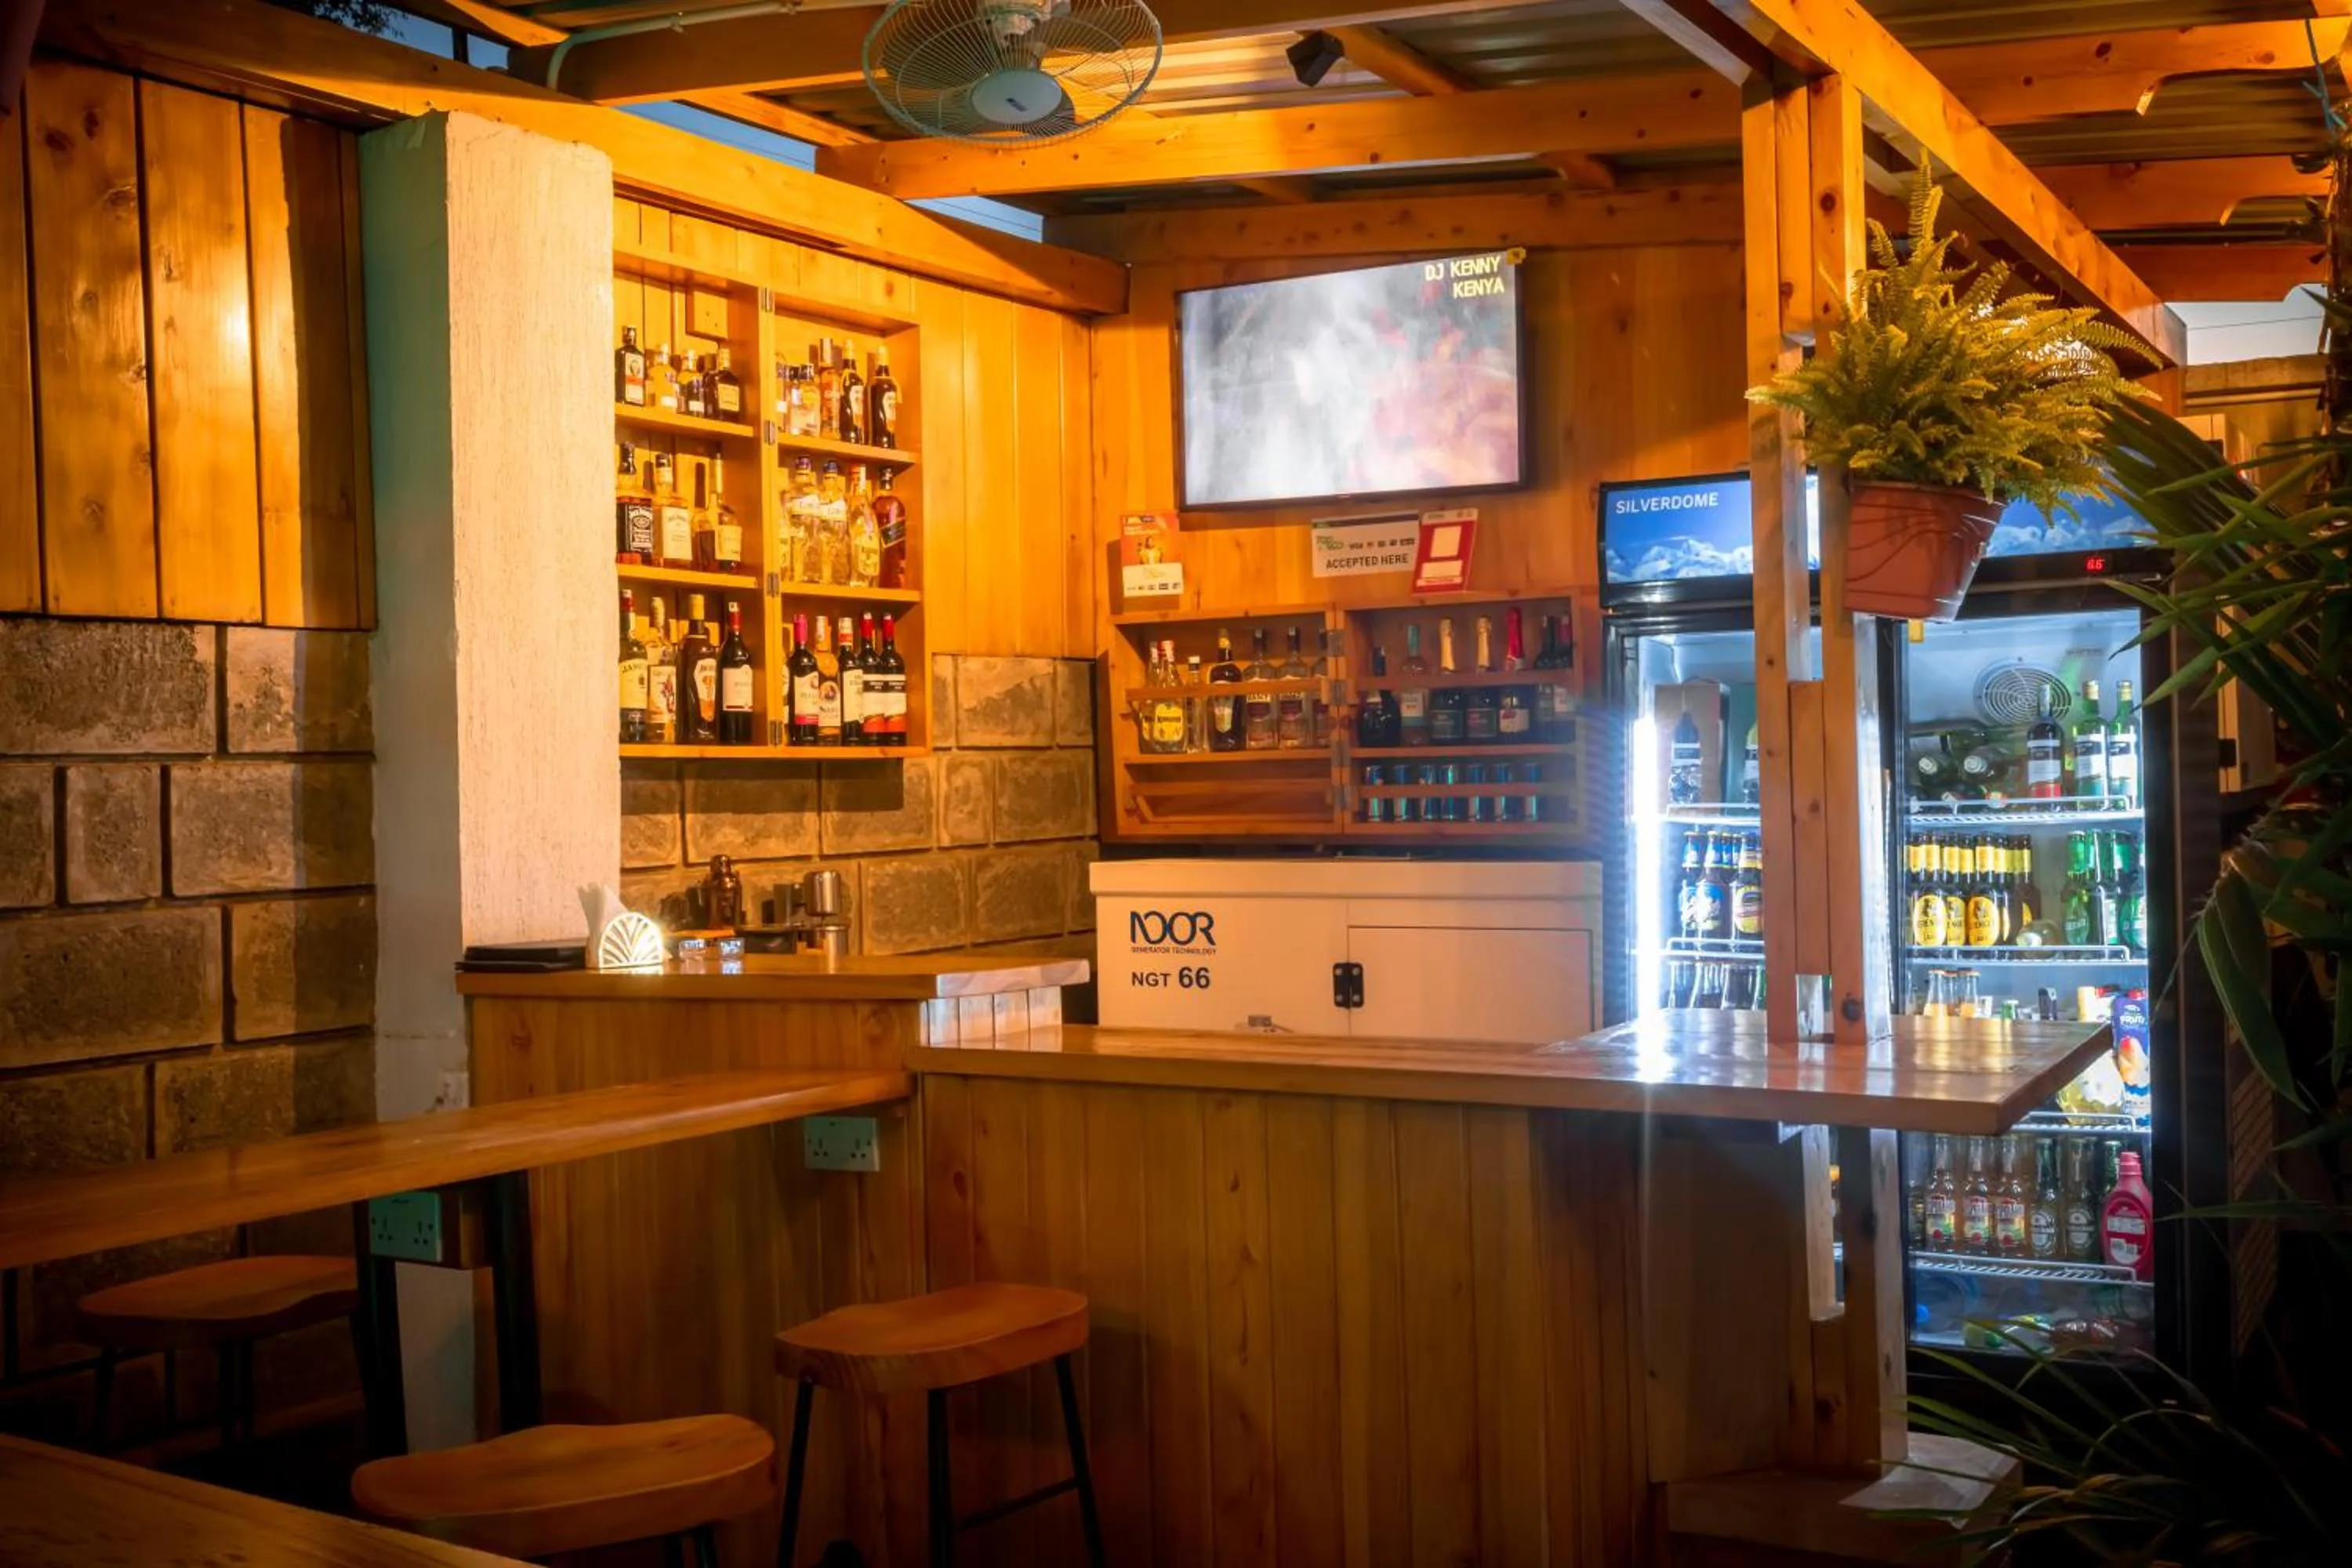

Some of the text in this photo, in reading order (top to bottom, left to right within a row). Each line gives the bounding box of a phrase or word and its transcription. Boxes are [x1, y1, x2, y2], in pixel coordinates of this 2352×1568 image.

[1425, 255, 1501, 281] DJ KENNY
[1453, 276, 1504, 299] KENYA
[1615, 492, 1719, 514] SILVERDOME
[1326, 554, 1409, 569] ACCEPTED HERE
[1130, 910, 1216, 946] NOOR
[1131, 967, 1210, 989] NGT 66
